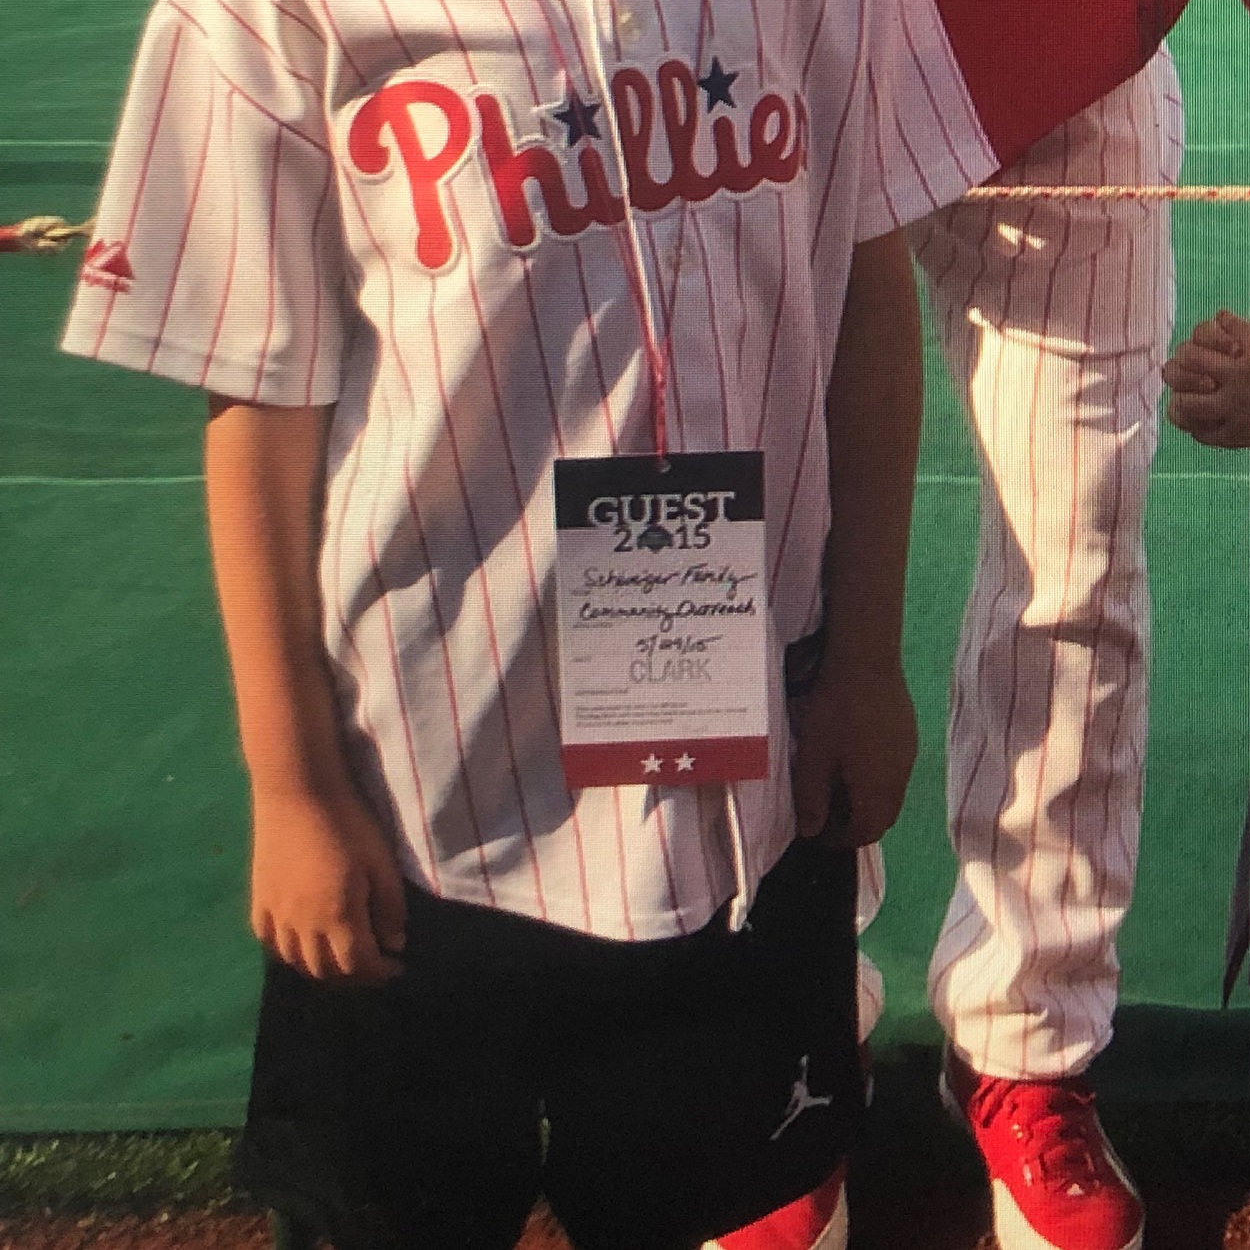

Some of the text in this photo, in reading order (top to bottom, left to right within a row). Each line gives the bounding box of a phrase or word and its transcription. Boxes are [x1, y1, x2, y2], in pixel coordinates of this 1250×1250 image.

[348, 58, 808, 270] Phillie
[586, 490, 736, 528] GUEST
[629, 657, 713, 684] CLARK
